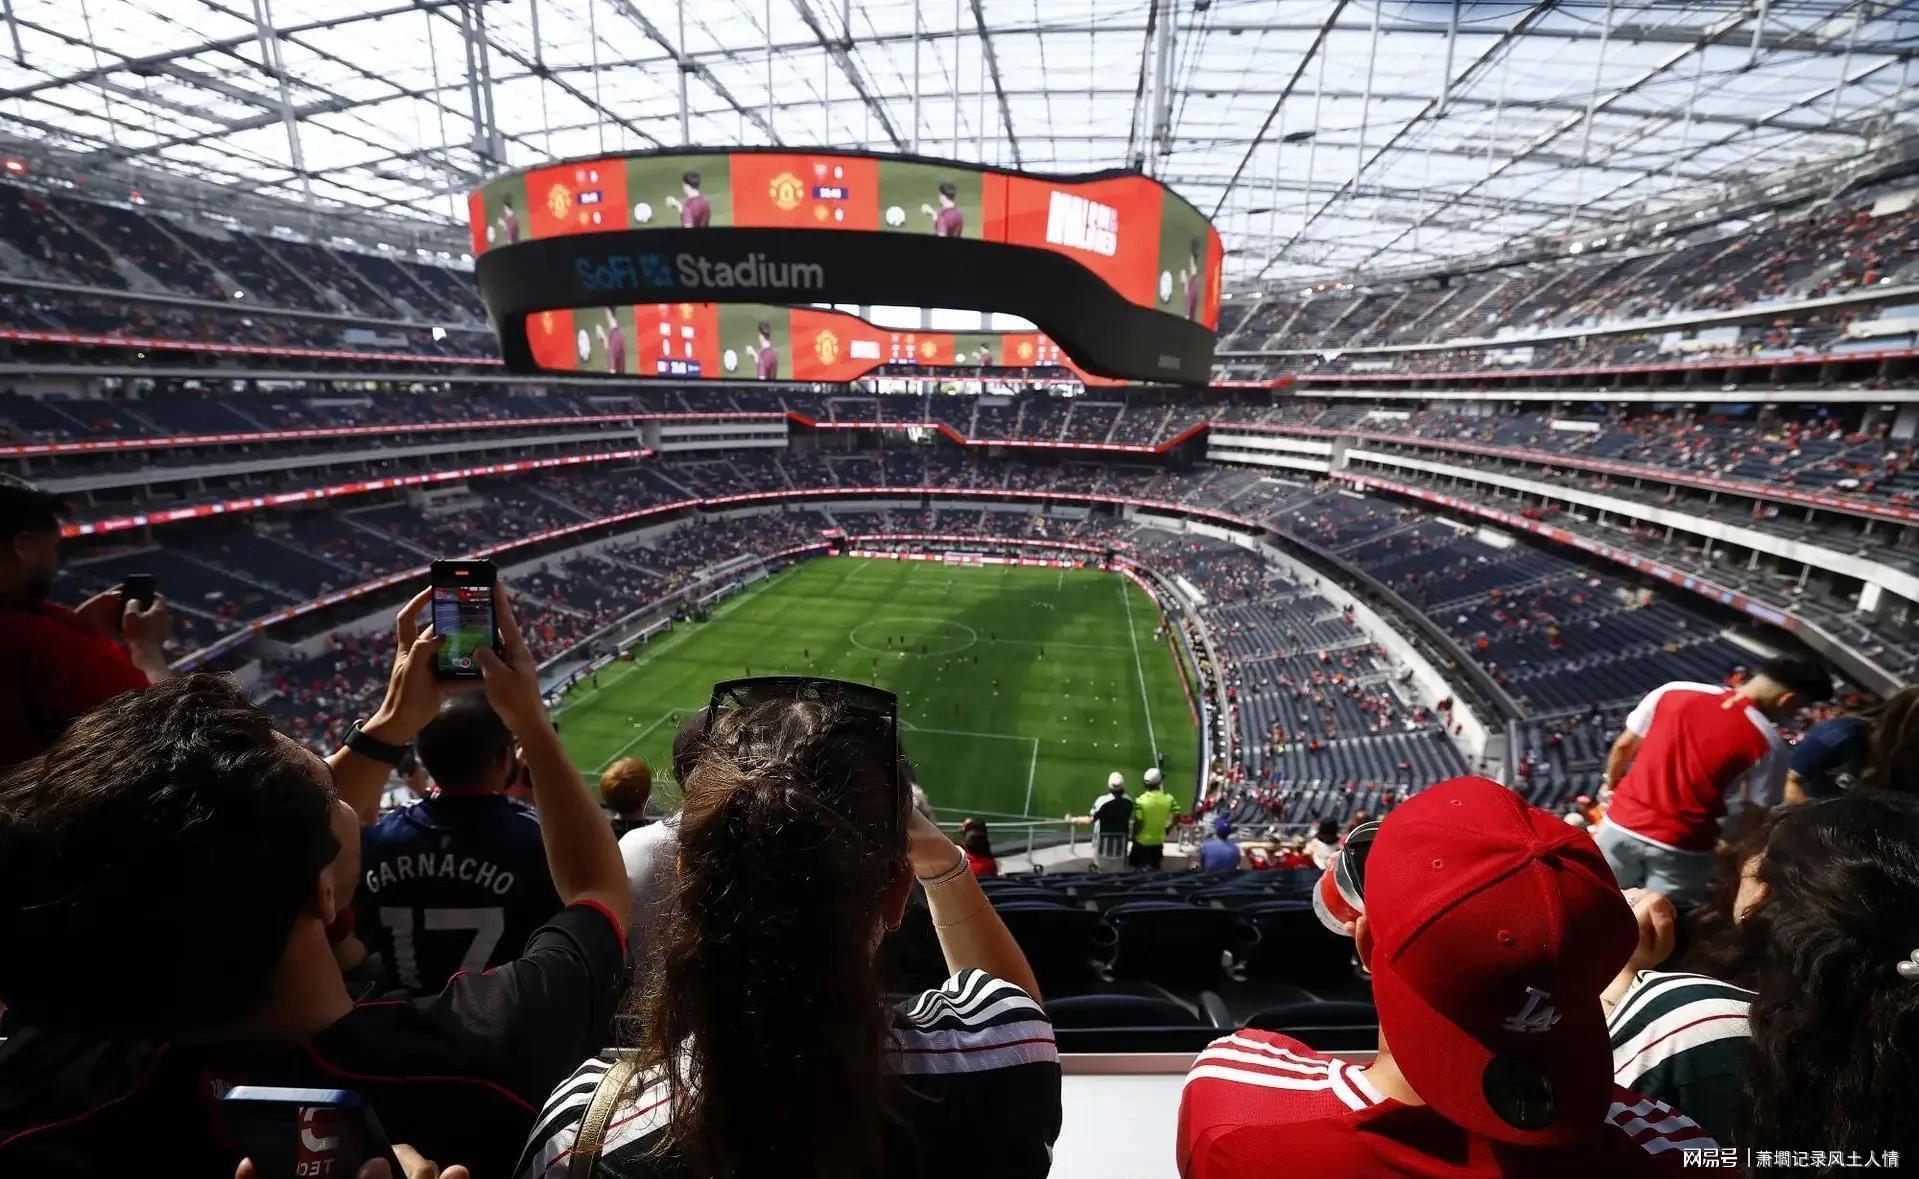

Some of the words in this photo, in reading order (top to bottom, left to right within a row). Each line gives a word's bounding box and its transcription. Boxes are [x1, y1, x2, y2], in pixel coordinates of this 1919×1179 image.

[575, 255, 638, 289] SoFi
[676, 253, 823, 288] Stadium
[366, 853, 514, 895] GARNACHO
[380, 906, 505, 989] 17
